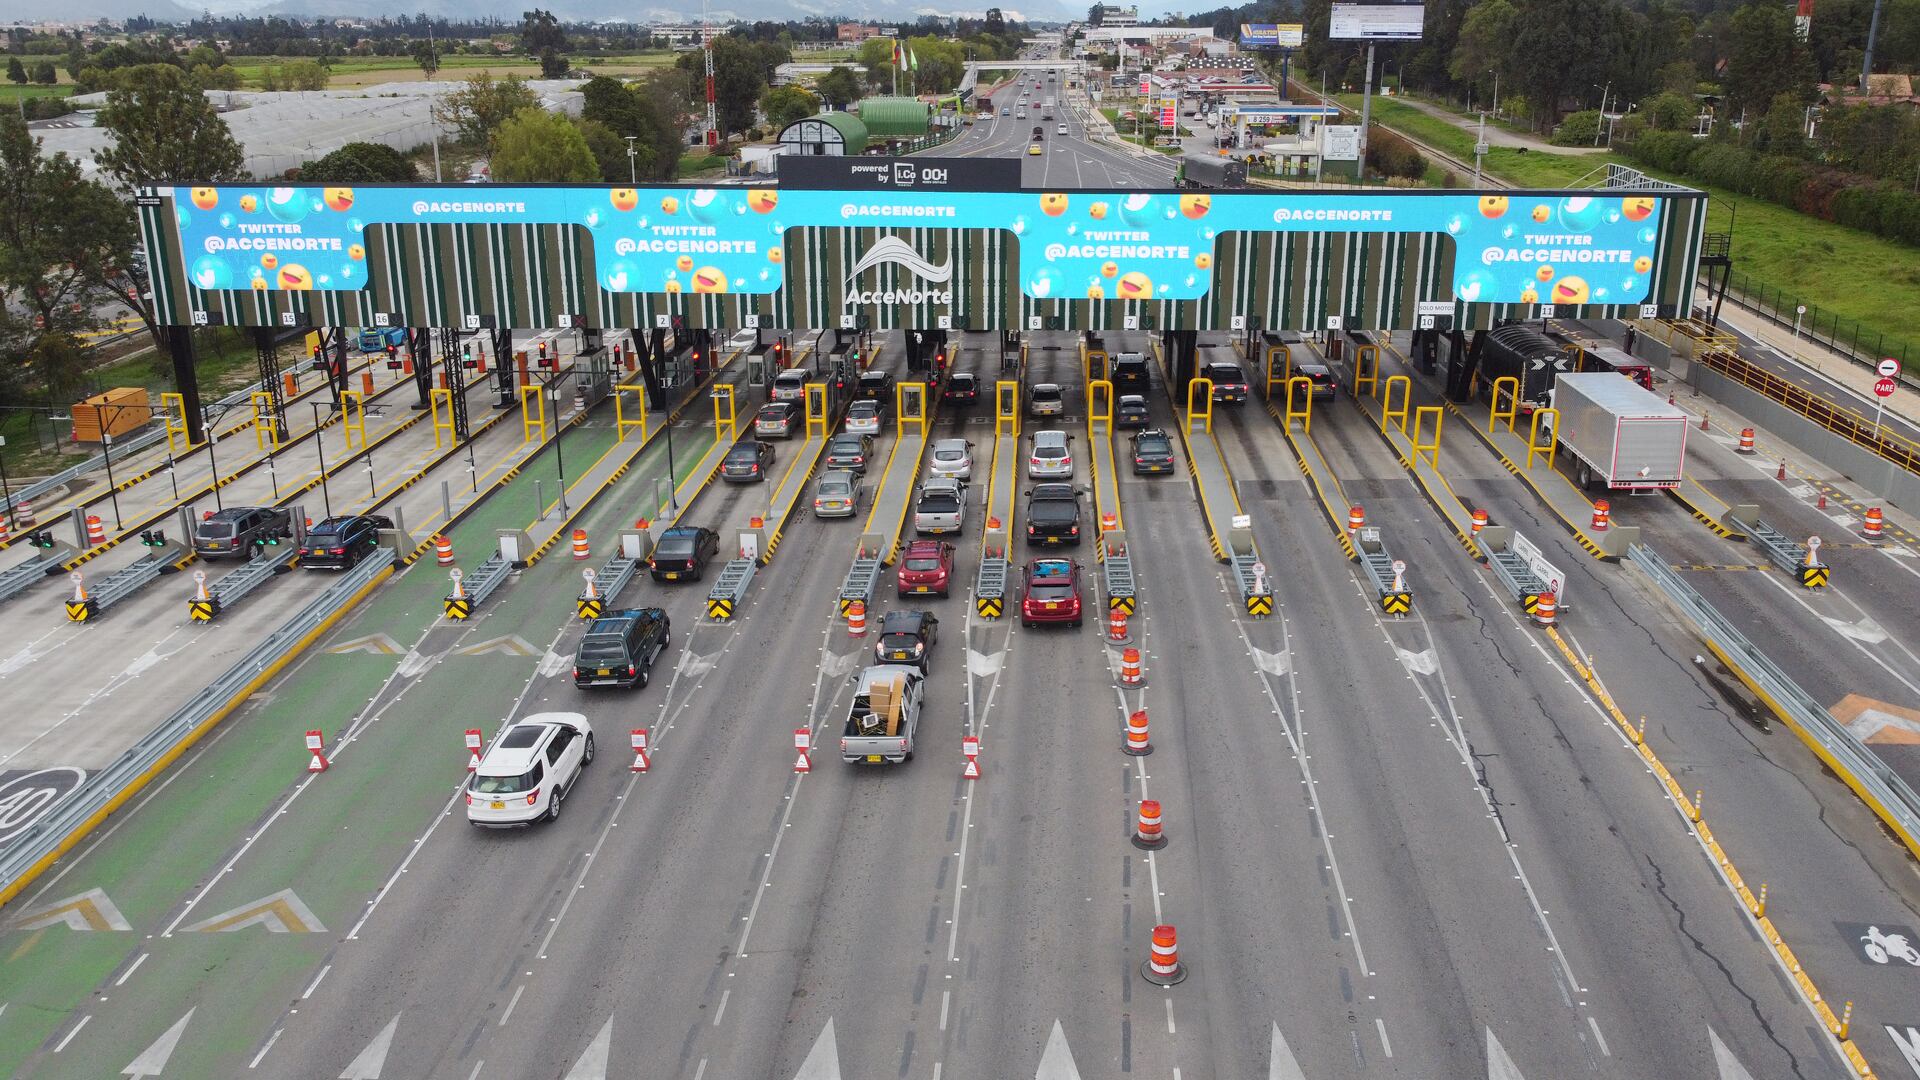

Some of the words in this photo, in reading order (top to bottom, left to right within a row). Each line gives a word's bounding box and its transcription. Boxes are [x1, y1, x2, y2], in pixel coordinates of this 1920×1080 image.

[851, 164, 889, 174] powered
[878, 174, 889, 183] by
[897, 169, 916, 179] i.Co
[412, 200, 526, 216] @ACCENORTE
[840, 203, 956, 219] @ACCENORTE
[1273, 208, 1392, 224] @ACCENORTE
[238, 223, 302, 234] TWITTER
[651, 225, 717, 237] TWITTER
[1083, 230, 1150, 242] TWITTER
[1524, 234, 1593, 245] TWITTER
[204, 235, 342, 254] @ACCENORTE
[615, 238, 757, 256] @ACCENORTE
[1044, 244, 1190, 262] @ACCENORTE
[1481, 246, 1632, 266] @ACCENORTE
[845, 288, 953, 305] AcceNorte
[1543, 307, 1553, 316] 11
[1645, 307, 1656, 316] 12
[196, 313, 207, 322] 14
[284, 315, 295, 324] 15
[376, 315, 387, 324] 16
[469, 316, 479, 325] 17
[562, 317, 568, 325] 1
[660, 317, 666, 325] 2
[749, 317, 755, 325] 3
[844, 317, 850, 325] 4
[942, 318, 948, 326] 5
[1032, 318, 1038, 326] 6
[1234, 318, 1240, 326] 8
[1331, 318, 1337, 326] 9
[1127, 318, 1133, 327] 7
[1422, 318, 1433, 327] 10
[1875, 383, 1894, 392] PARE
[1537, 564, 1549, 579] CARRIL
[0, 788, 57, 829] 40
